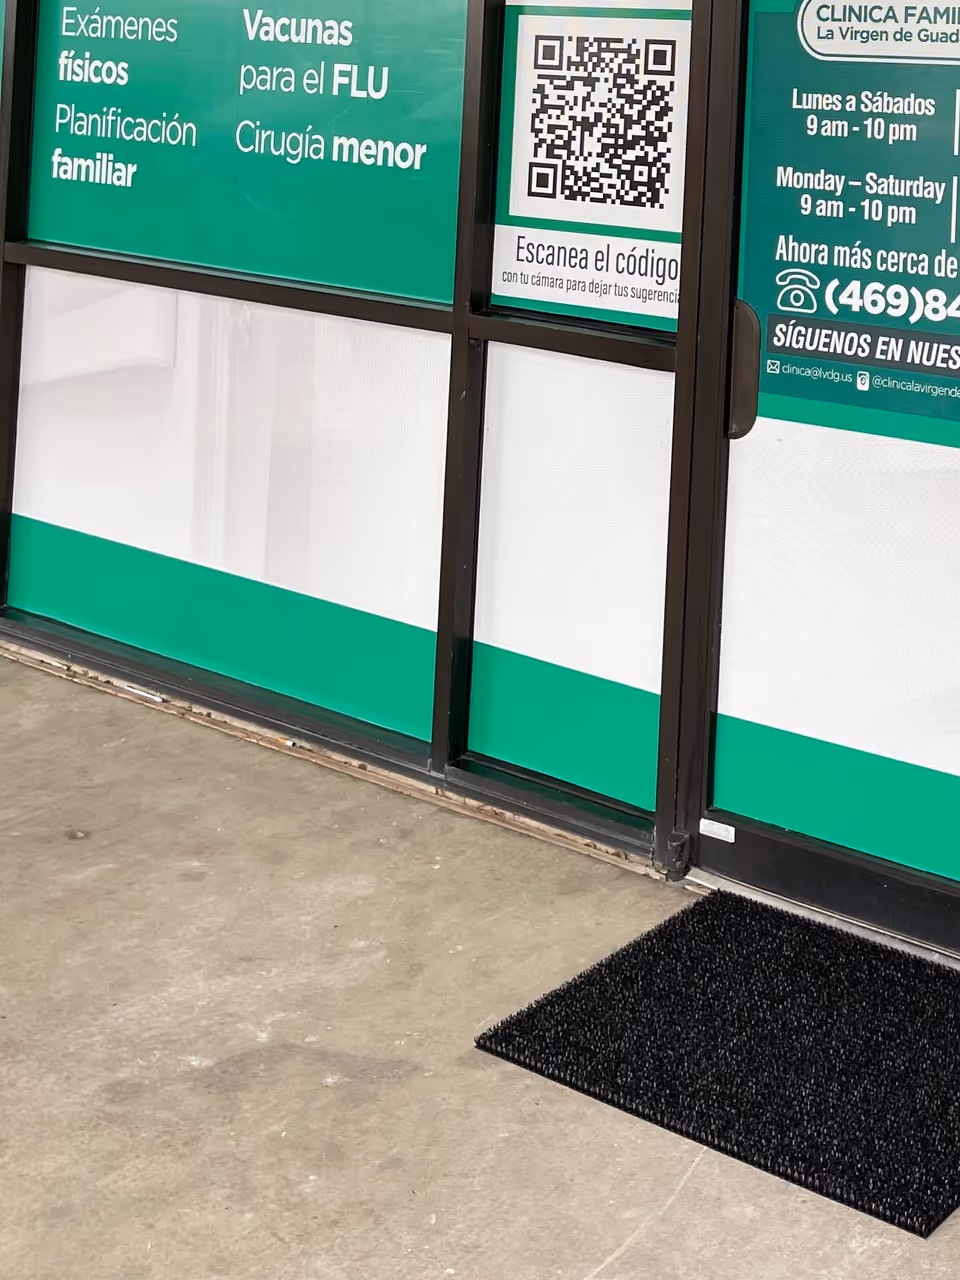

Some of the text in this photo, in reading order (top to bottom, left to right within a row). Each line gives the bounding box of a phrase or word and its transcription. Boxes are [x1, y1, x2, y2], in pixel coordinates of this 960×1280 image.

[62, 7, 177, 43] Exámenes
[243, 8, 353, 46] Vacunas
[816, 4, 899, 24] CLINICA
[816, 26, 834, 40] La
[839, 26, 889, 44] Virgen
[893, 27, 912, 42] de
[58, 50, 129, 86] físicos
[239, 61, 389, 100] para el FLU
[792, 88, 936, 116] Lunes a Sábados
[55, 103, 197, 147] Planificación
[806, 114, 818, 136] 9
[821, 119, 849, 137] am
[863, 117, 886, 140] 10
[888, 123, 917, 145] pm
[235, 120, 427, 170] Cirugía menor
[51, 148, 137, 187] familiar
[776, 166, 846, 196] Monday
[865, 172, 946, 205] Saturday
[800, 194, 812, 215] 9
[815, 199, 844, 218] am
[860, 198, 883, 222] 10
[887, 205, 917, 227] pm
[516, 235, 678, 286] Escanea el código
[775, 234, 829, 266] Ahora
[833, 240, 872, 269] más
[876, 249, 929, 276] cerca
[934, 249, 958, 278] de
[502, 270, 518, 283] con
[520, 271, 529, 285] tu
[531, 272, 564, 290] cámara
[566, 279, 586, 293] para
[588, 279, 612, 297] dejar
[614, 283, 628, 297] tus
[773, 320, 872, 358] SÍGUENOS
[875, 336, 903, 362] EN
[781, 364, 853, 383] clinica@lvdg.us
